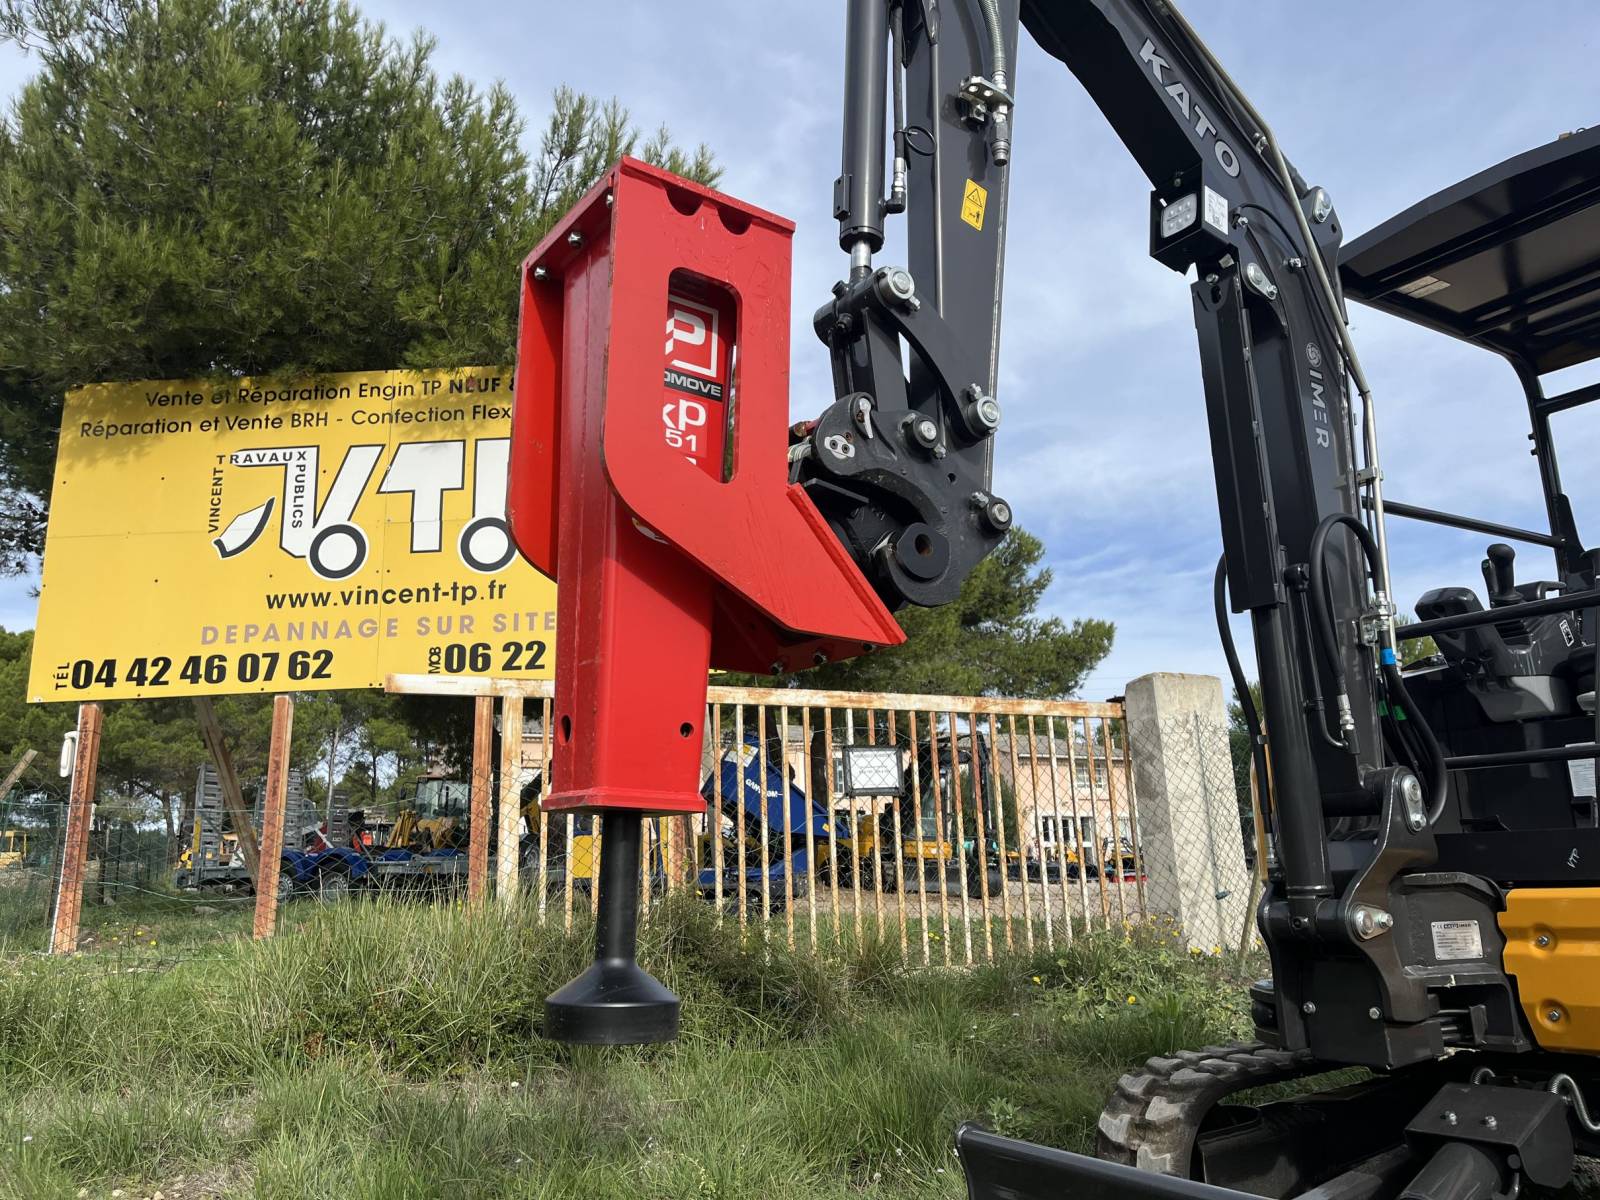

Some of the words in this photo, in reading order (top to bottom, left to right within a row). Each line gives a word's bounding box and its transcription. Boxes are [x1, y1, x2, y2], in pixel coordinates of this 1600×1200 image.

[1139, 37, 1240, 179] KATO
[146, 390, 204, 408] Vente
[211, 388, 231, 405] et
[238, 383, 351, 407] Réparation
[359, 382, 414, 401] Engin
[421, 380, 442, 396] TP
[1309, 369, 1330, 448] IMER
[80, 416, 192, 440] Réparation
[199, 415, 220, 433] et
[225, 414, 283, 432] Vente
[291, 411, 329, 428] BRH
[351, 406, 465, 426] Confection
[664, 428, 697, 453] 51
[216, 450, 307, 466] TRAVAUX
[207, 466, 224, 534] VINCENT
[291, 464, 307, 529] PUBLICS
[265, 579, 507, 610] www.vincent-tp.fr
[200, 617, 399, 646] DEPANNAGE
[416, 613, 475, 637] SUR
[493, 611, 555, 634] SITE
[53, 662, 70, 690] TÉL
[71, 658, 117, 690] 04
[126, 655, 173, 687] 42
[179, 653, 228, 685] 46
[237, 651, 280, 683] 07
[287, 648, 334, 681] 62
[428, 646, 442, 674] MOB
[444, 641, 492, 674] 06
[501, 640, 547, 672] 22
